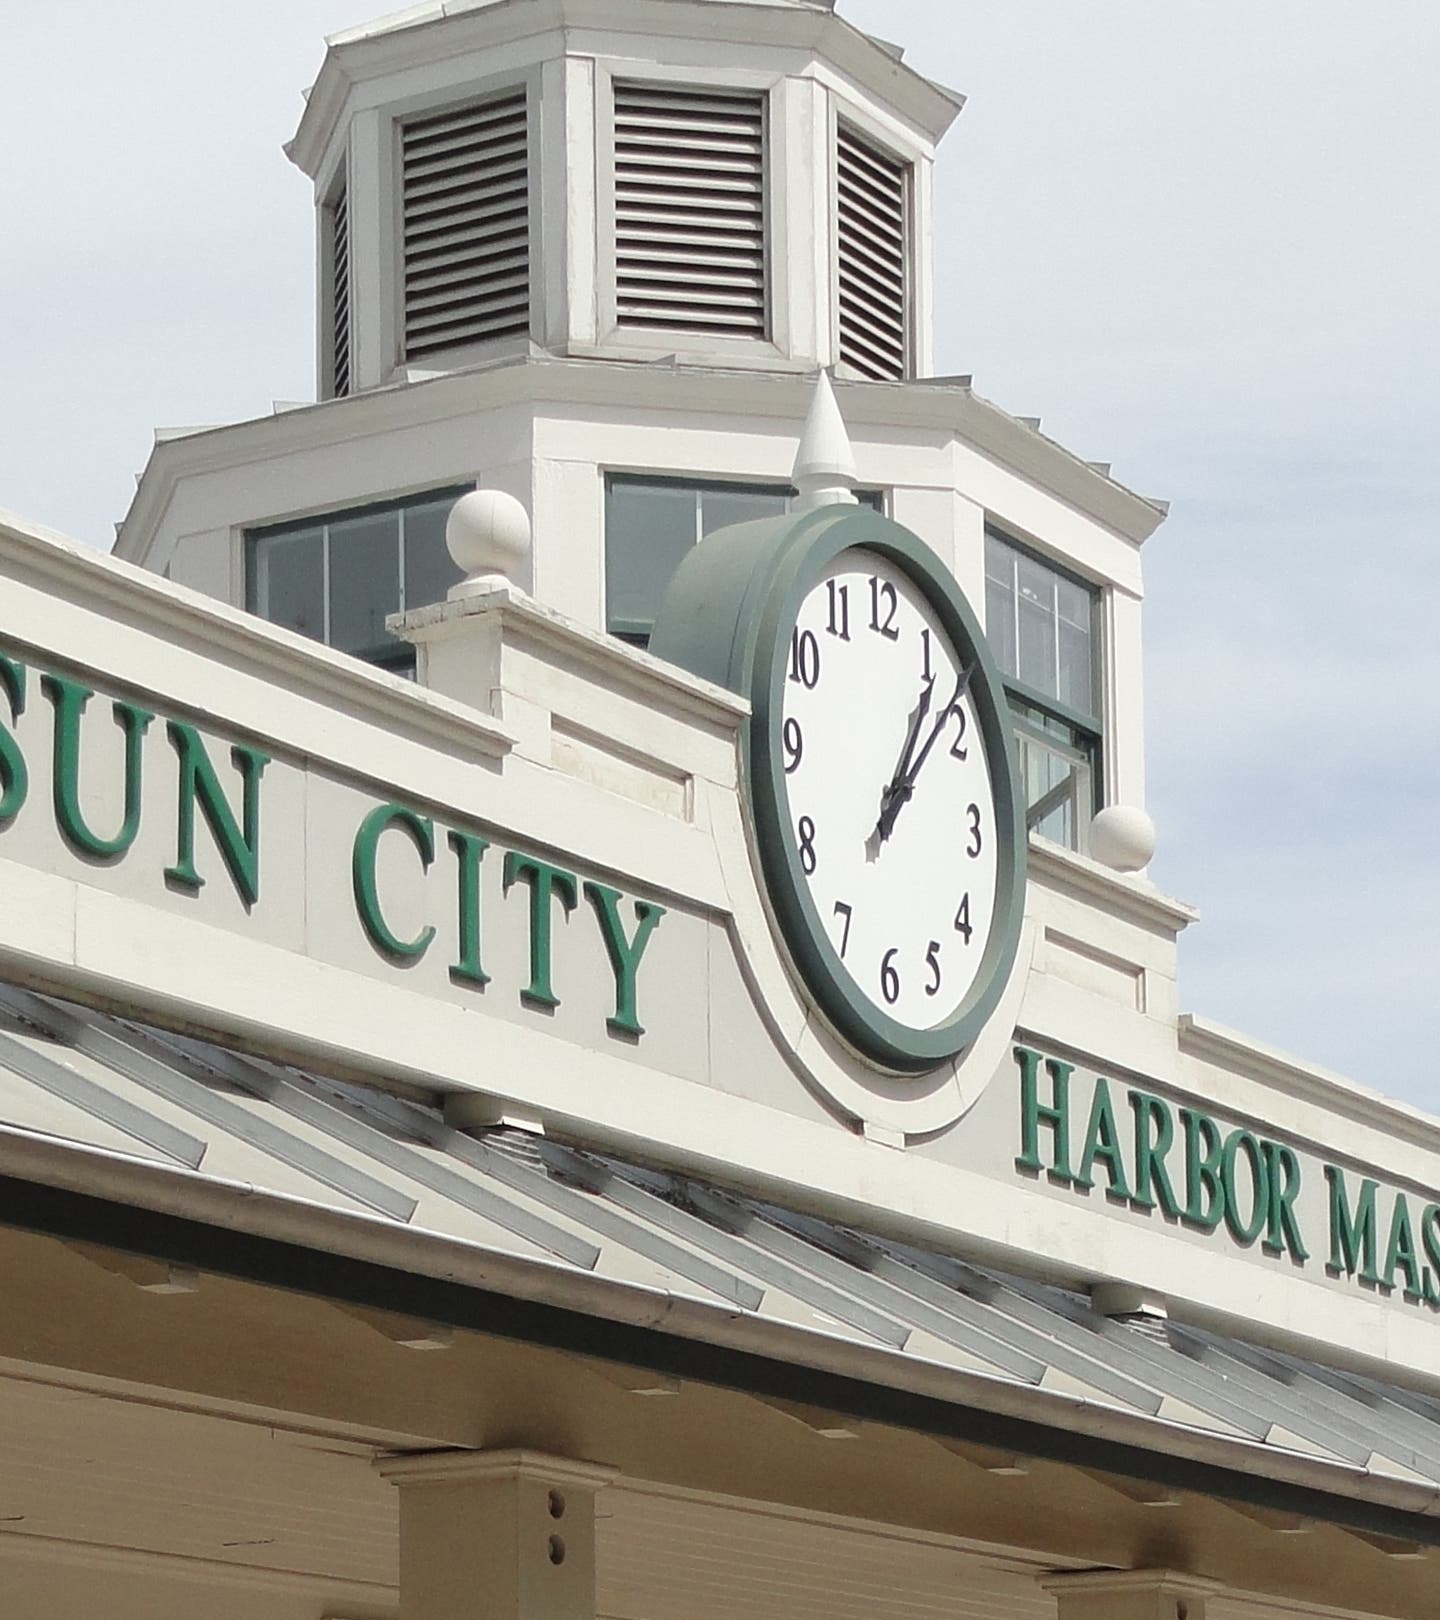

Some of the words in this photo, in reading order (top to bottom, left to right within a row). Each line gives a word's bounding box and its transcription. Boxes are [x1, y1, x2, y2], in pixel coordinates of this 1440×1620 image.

[826, 579, 851, 642] 11
[868, 576, 900, 641] 12
[789, 624, 820, 690] 10
[921, 628, 934, 683] 1
[783, 717, 803, 774] 9
[949, 704, 968, 762] 2
[798, 815, 817, 876] 8
[966, 803, 982, 859] 3
[354, 803, 667, 1037] CITY
[833, 901, 853, 959] 7
[954, 892, 973, 946] 4
[881, 947, 900, 1005] 6
[925, 940, 941, 997] 5
[1014, 1046, 1310, 1263] HARBOR
